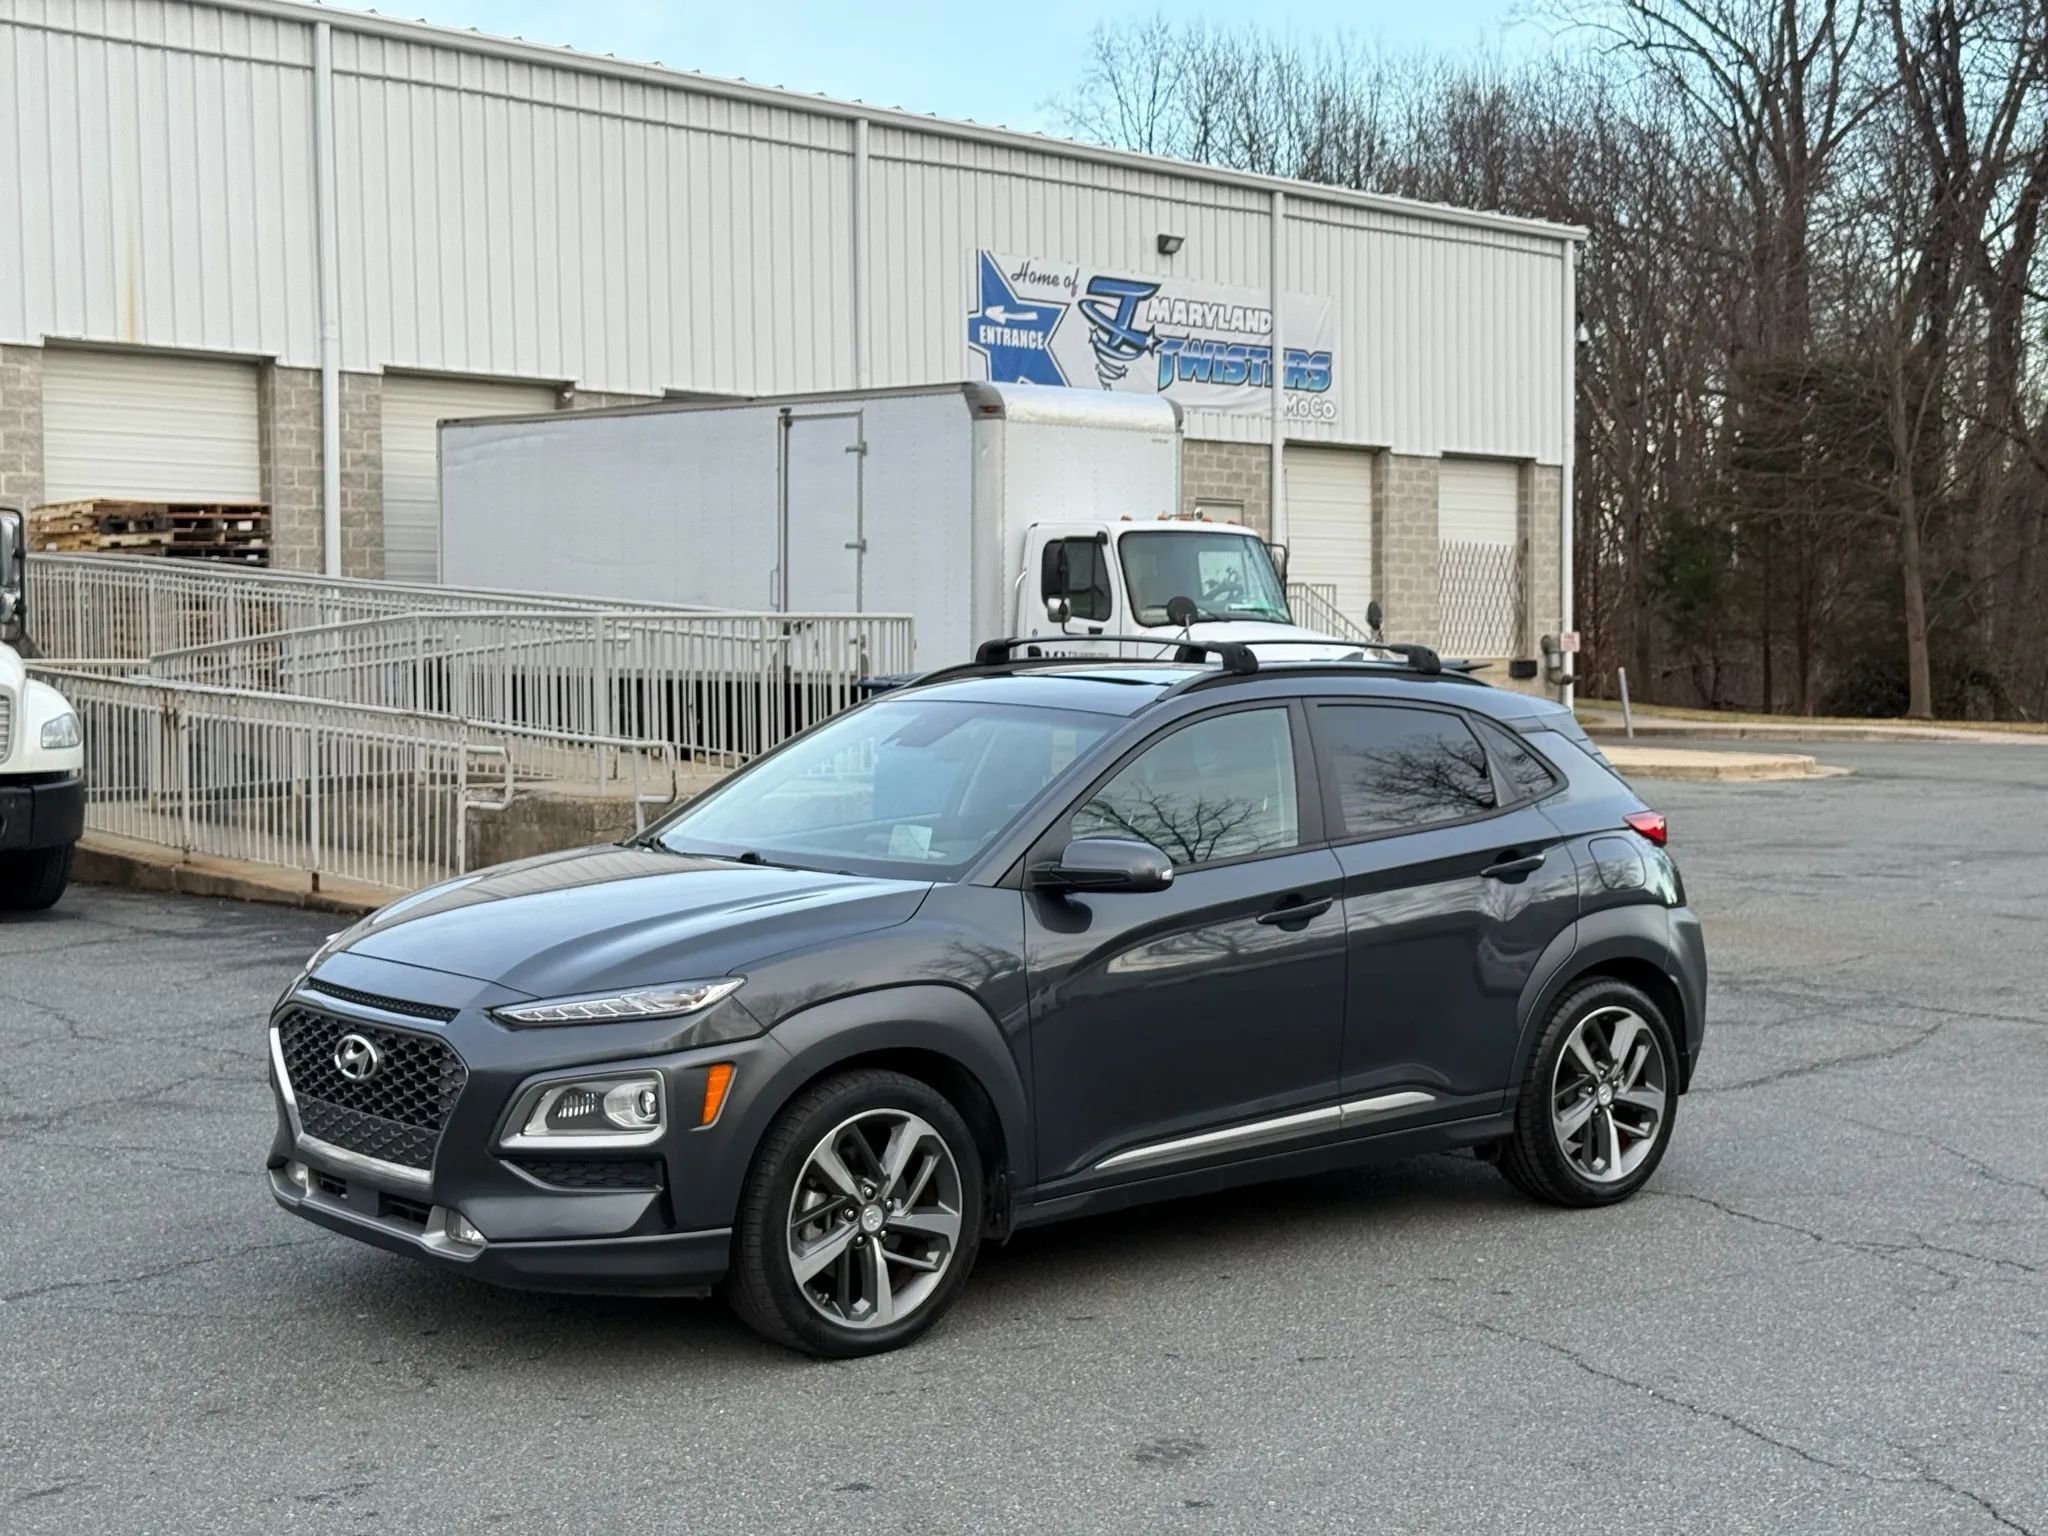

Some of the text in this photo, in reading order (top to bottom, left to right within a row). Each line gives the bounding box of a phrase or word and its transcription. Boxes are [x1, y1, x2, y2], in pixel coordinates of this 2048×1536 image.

[1011, 260, 1080, 298] Home of
[1147, 296, 1273, 335] MARYLAND
[979, 324, 1045, 350] ENTRANCE
